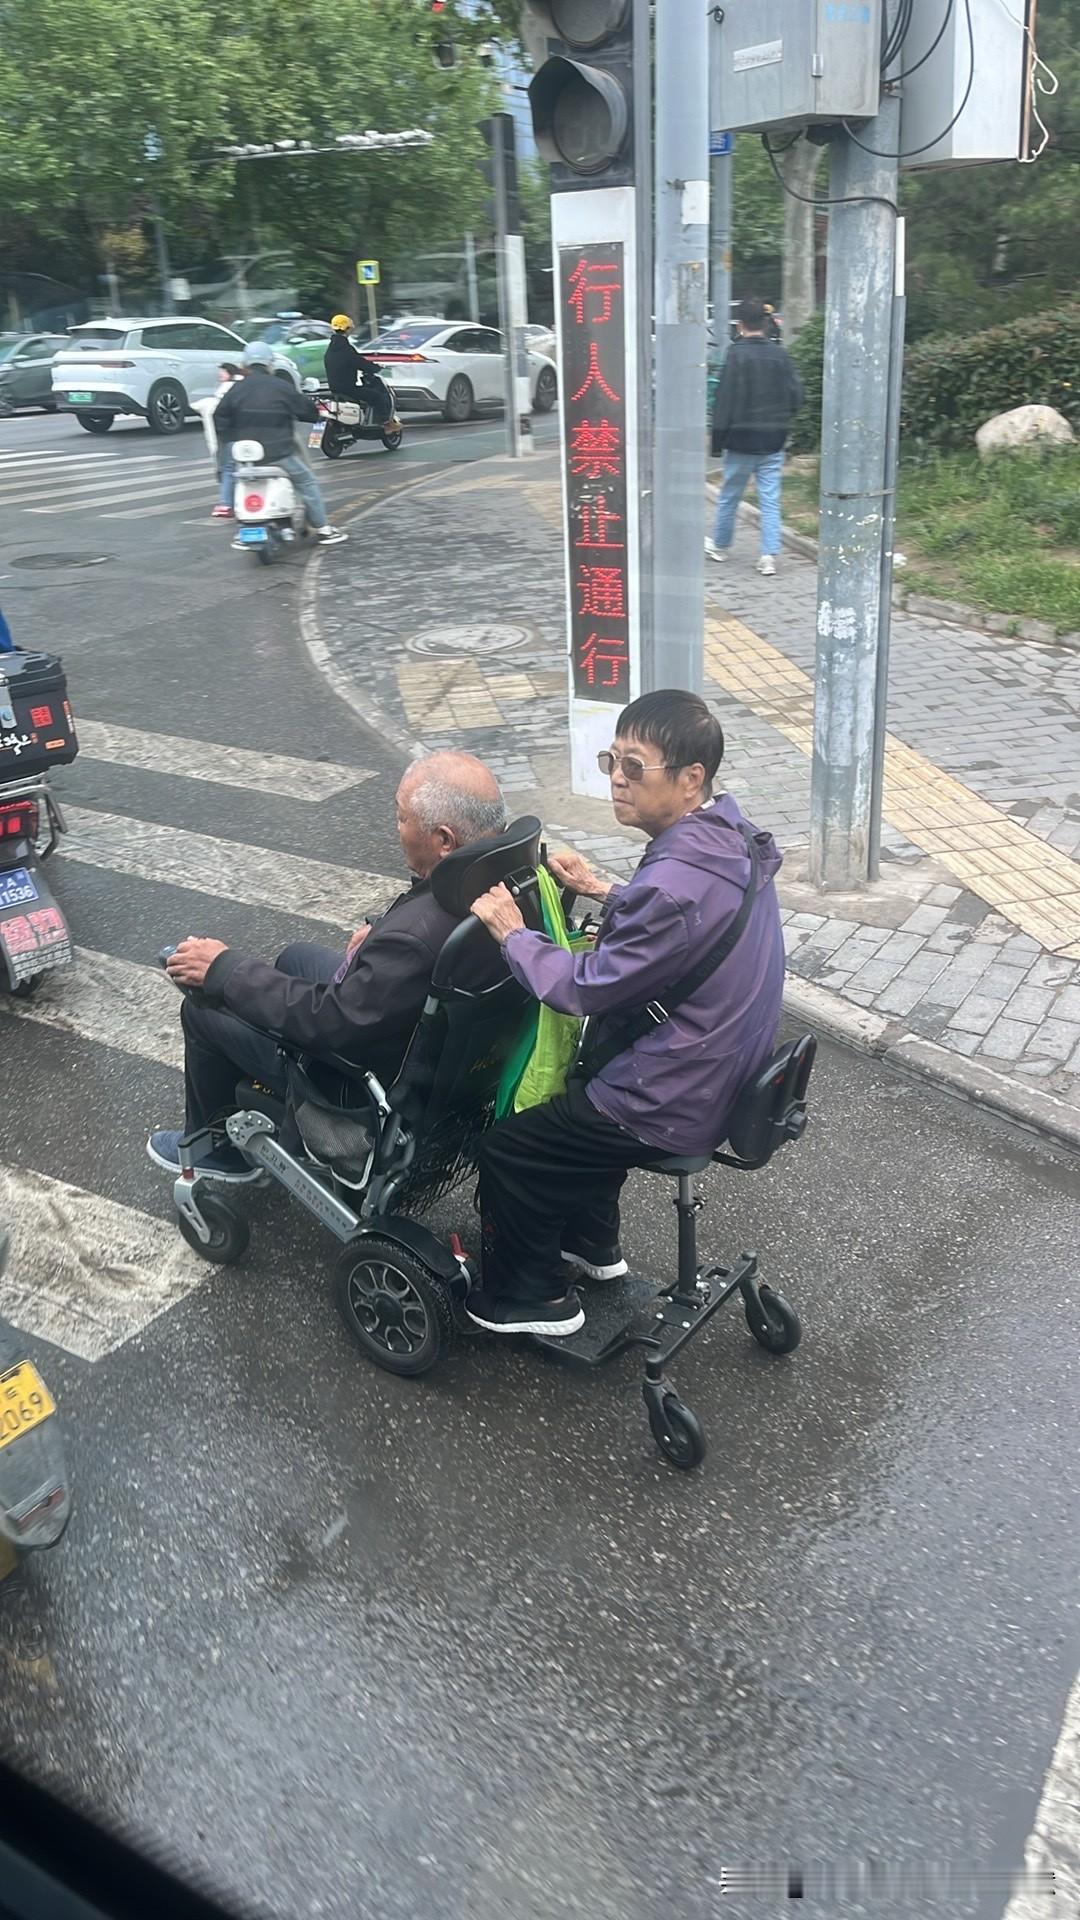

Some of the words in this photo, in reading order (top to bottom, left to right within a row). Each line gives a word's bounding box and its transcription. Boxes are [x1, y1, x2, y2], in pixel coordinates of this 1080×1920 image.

[568, 258, 629, 688] 行人禁止通行
